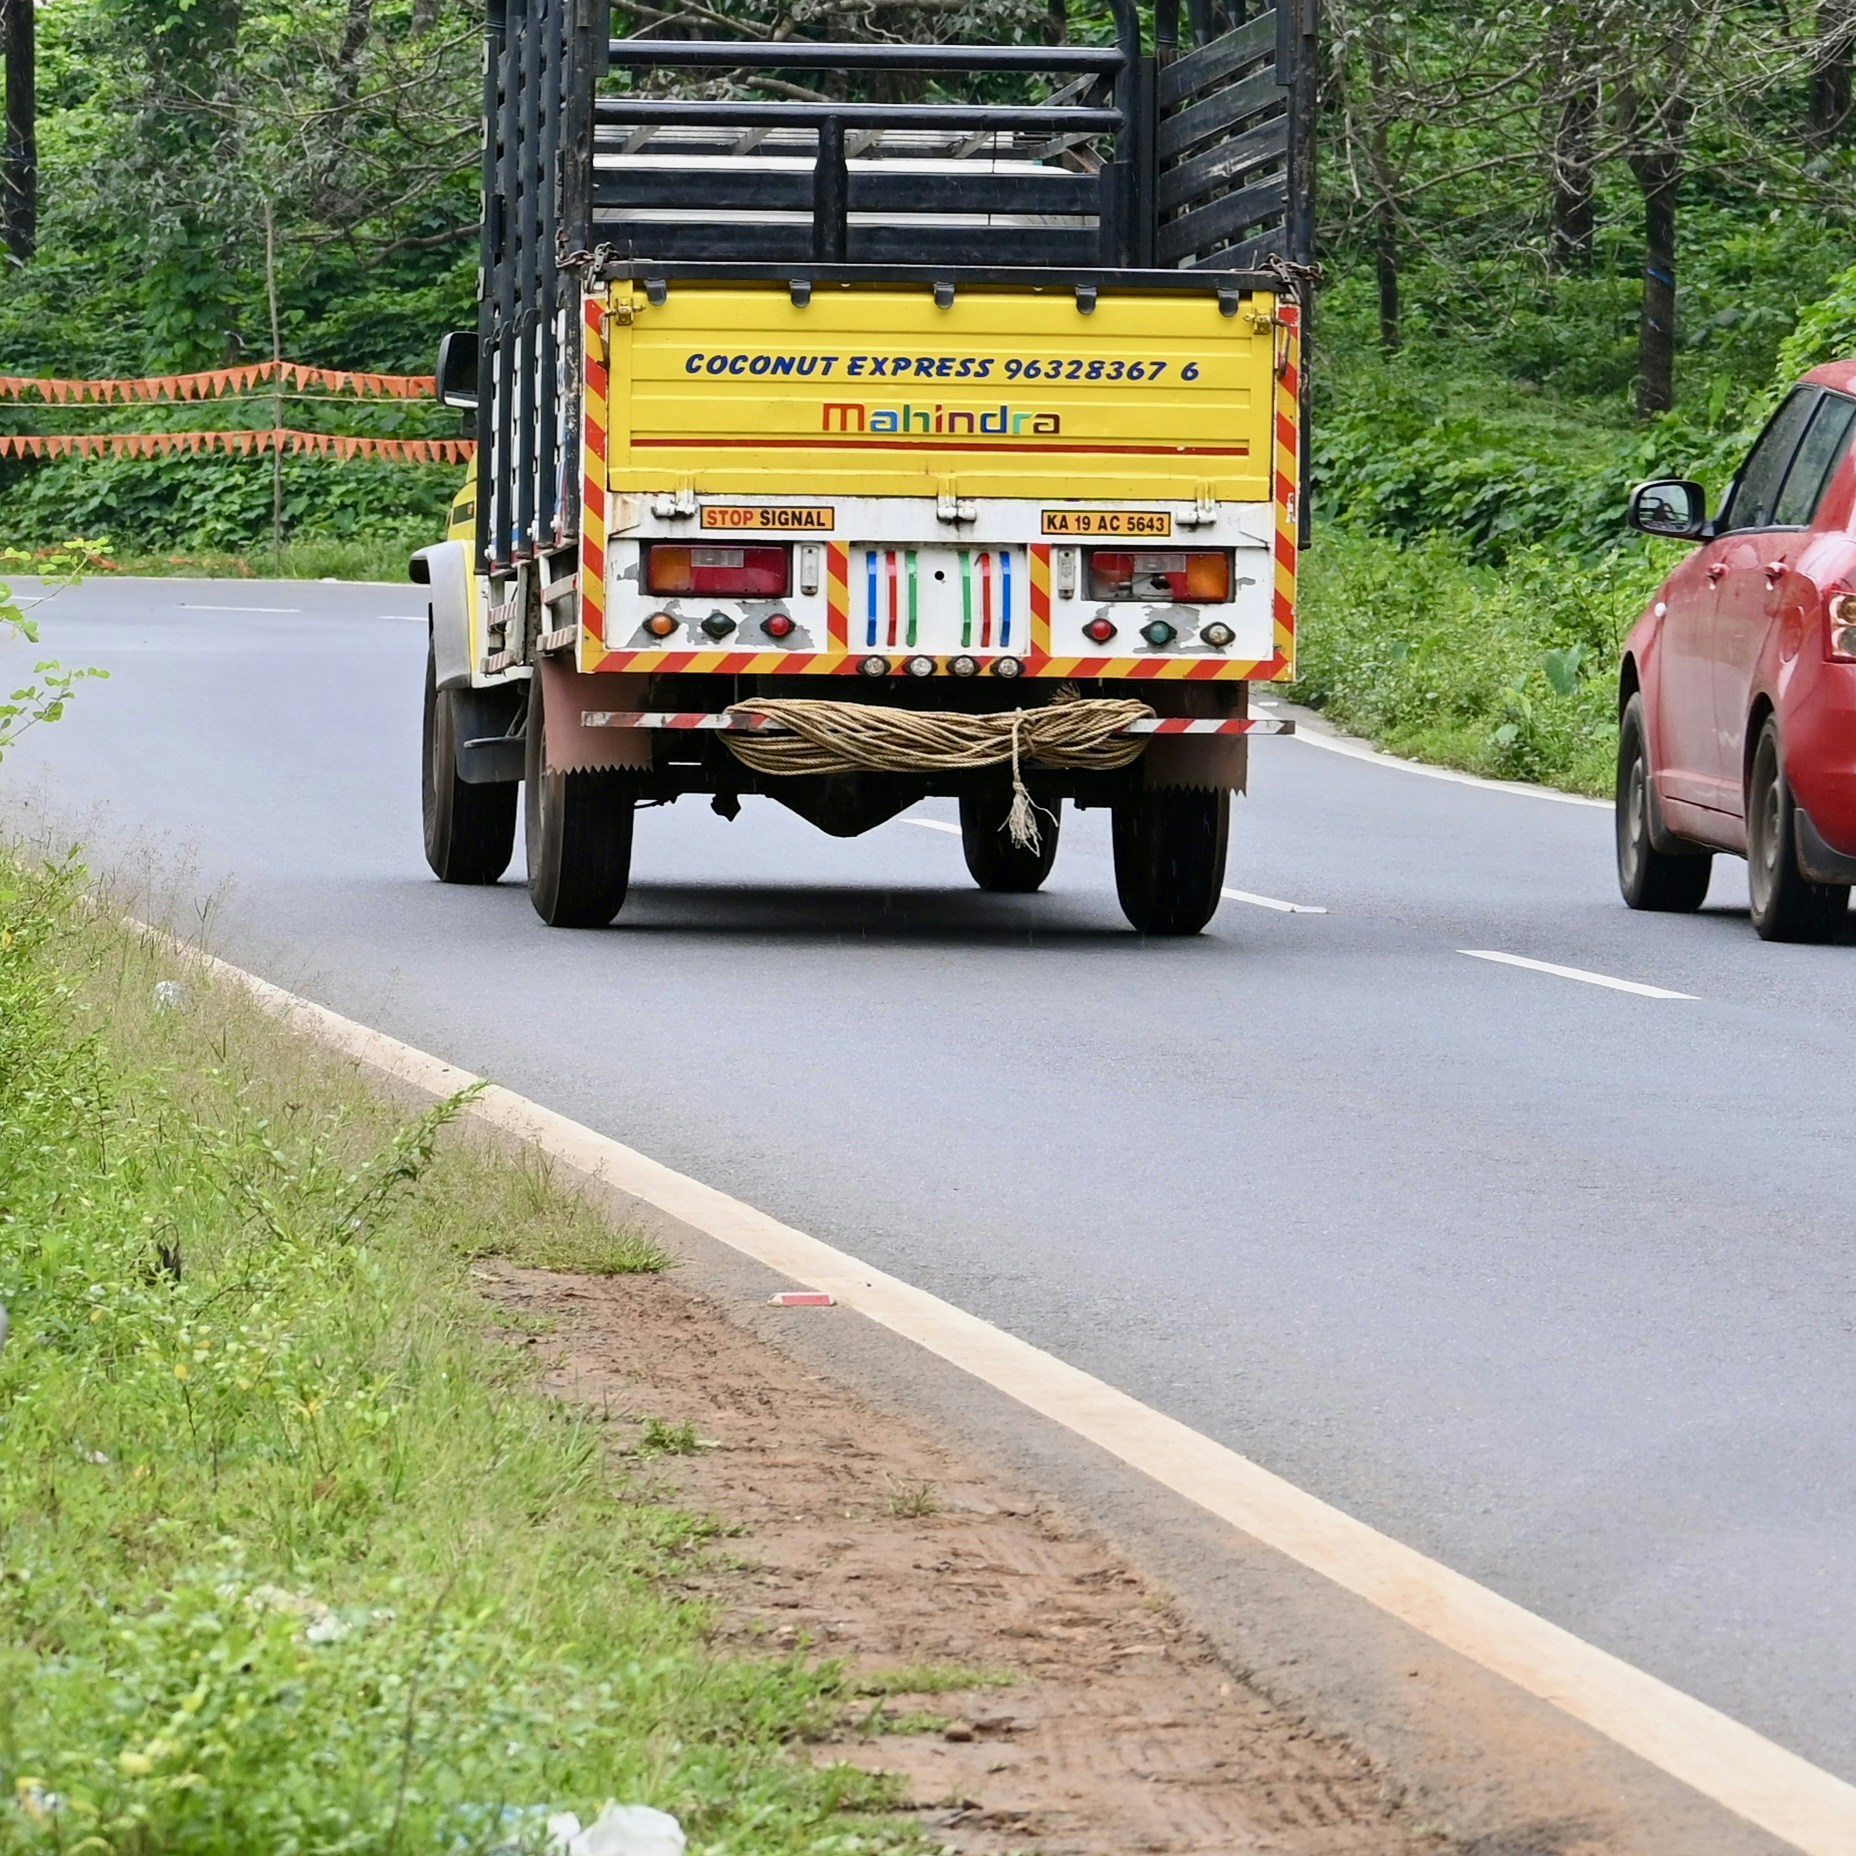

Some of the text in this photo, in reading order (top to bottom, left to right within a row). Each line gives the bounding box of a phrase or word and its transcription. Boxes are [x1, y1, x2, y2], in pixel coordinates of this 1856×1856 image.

[685, 354, 1200, 381] COCONUT EXPRESS 96328367 6
[707, 509, 826, 527] STOP SIGNAL
[1047, 514, 1165, 532] KA 19 AC 5643
